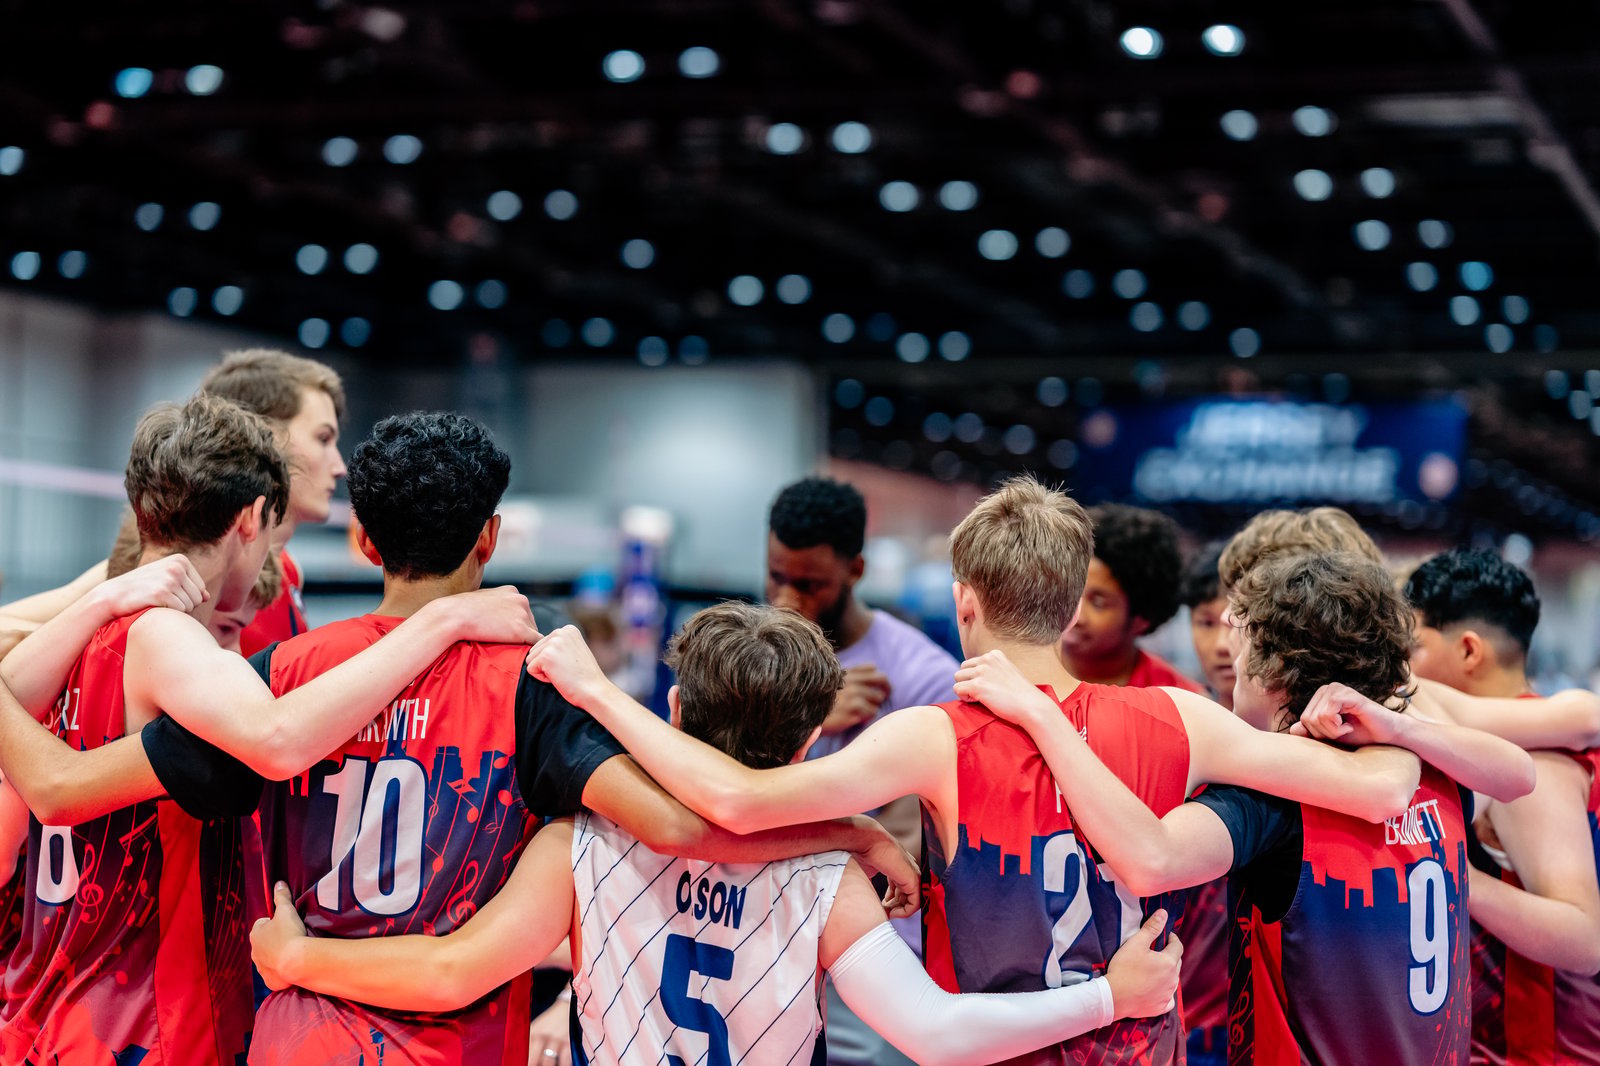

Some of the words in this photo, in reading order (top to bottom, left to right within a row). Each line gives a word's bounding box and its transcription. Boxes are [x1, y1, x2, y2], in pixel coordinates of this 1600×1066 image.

[315, 757, 427, 916] 10
[675, 870, 747, 930] OSON
[659, 932, 735, 1066] 5
[1408, 858, 1449, 1015] 9
